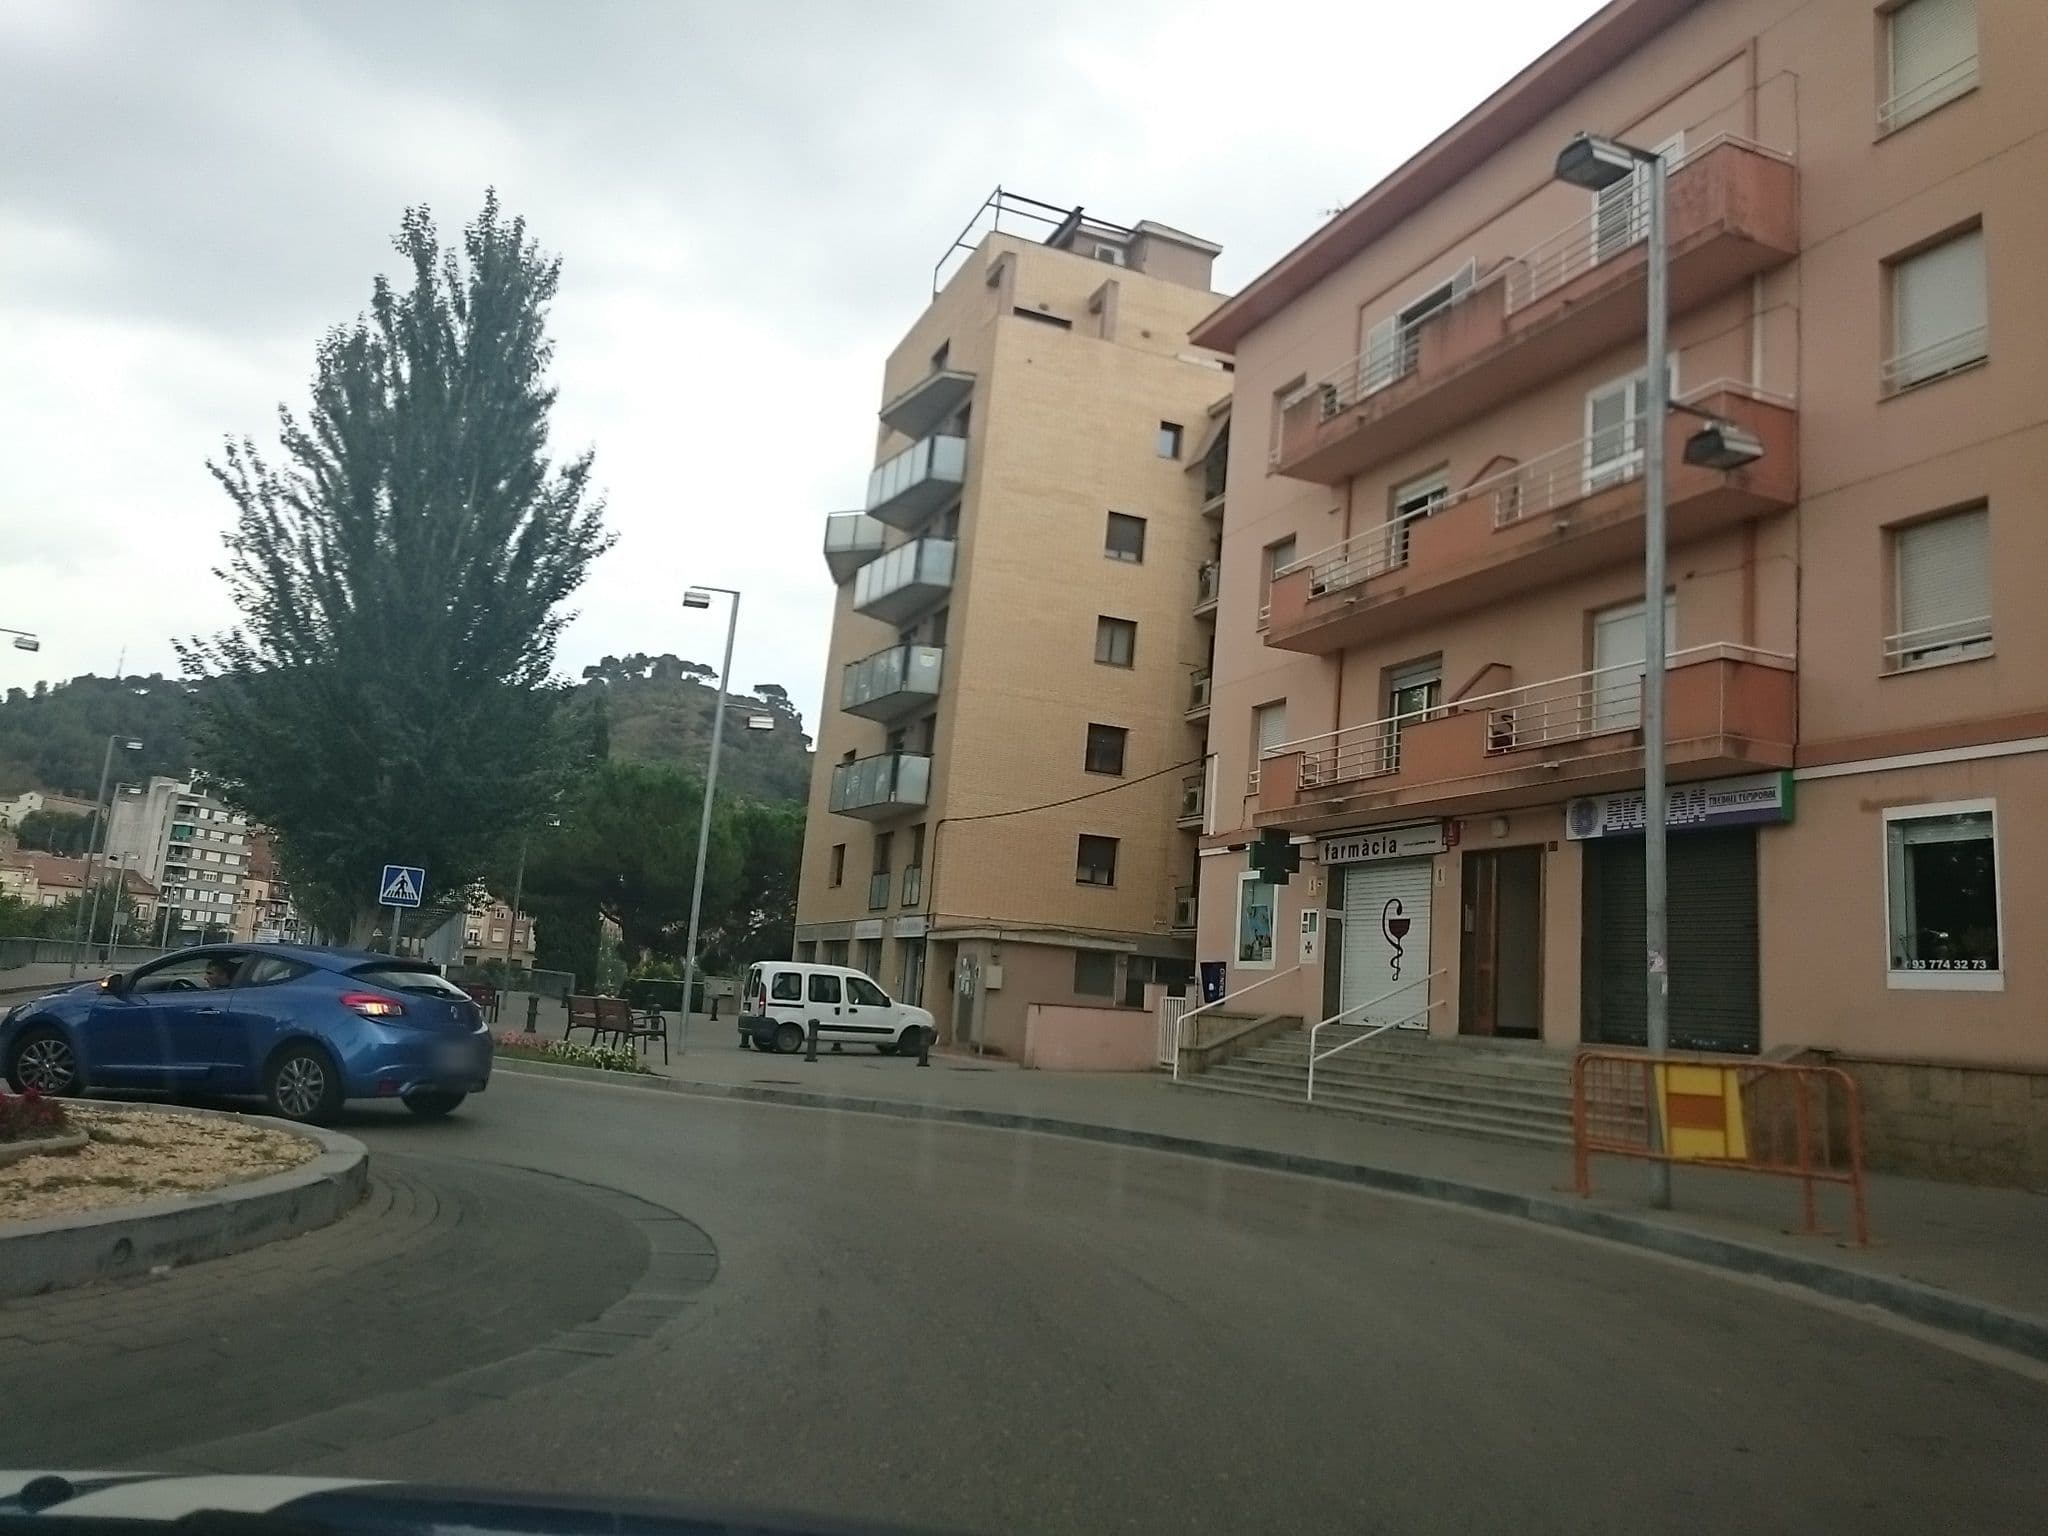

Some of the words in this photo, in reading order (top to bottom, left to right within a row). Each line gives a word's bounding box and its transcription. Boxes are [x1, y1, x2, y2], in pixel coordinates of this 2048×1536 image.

[1324, 836, 1397, 861] farmàcia
[1911, 959, 1926, 969] 93
[1929, 959, 1950, 969] 774
[1954, 959, 1968, 969] 32
[1972, 959, 1987, 969] 73
